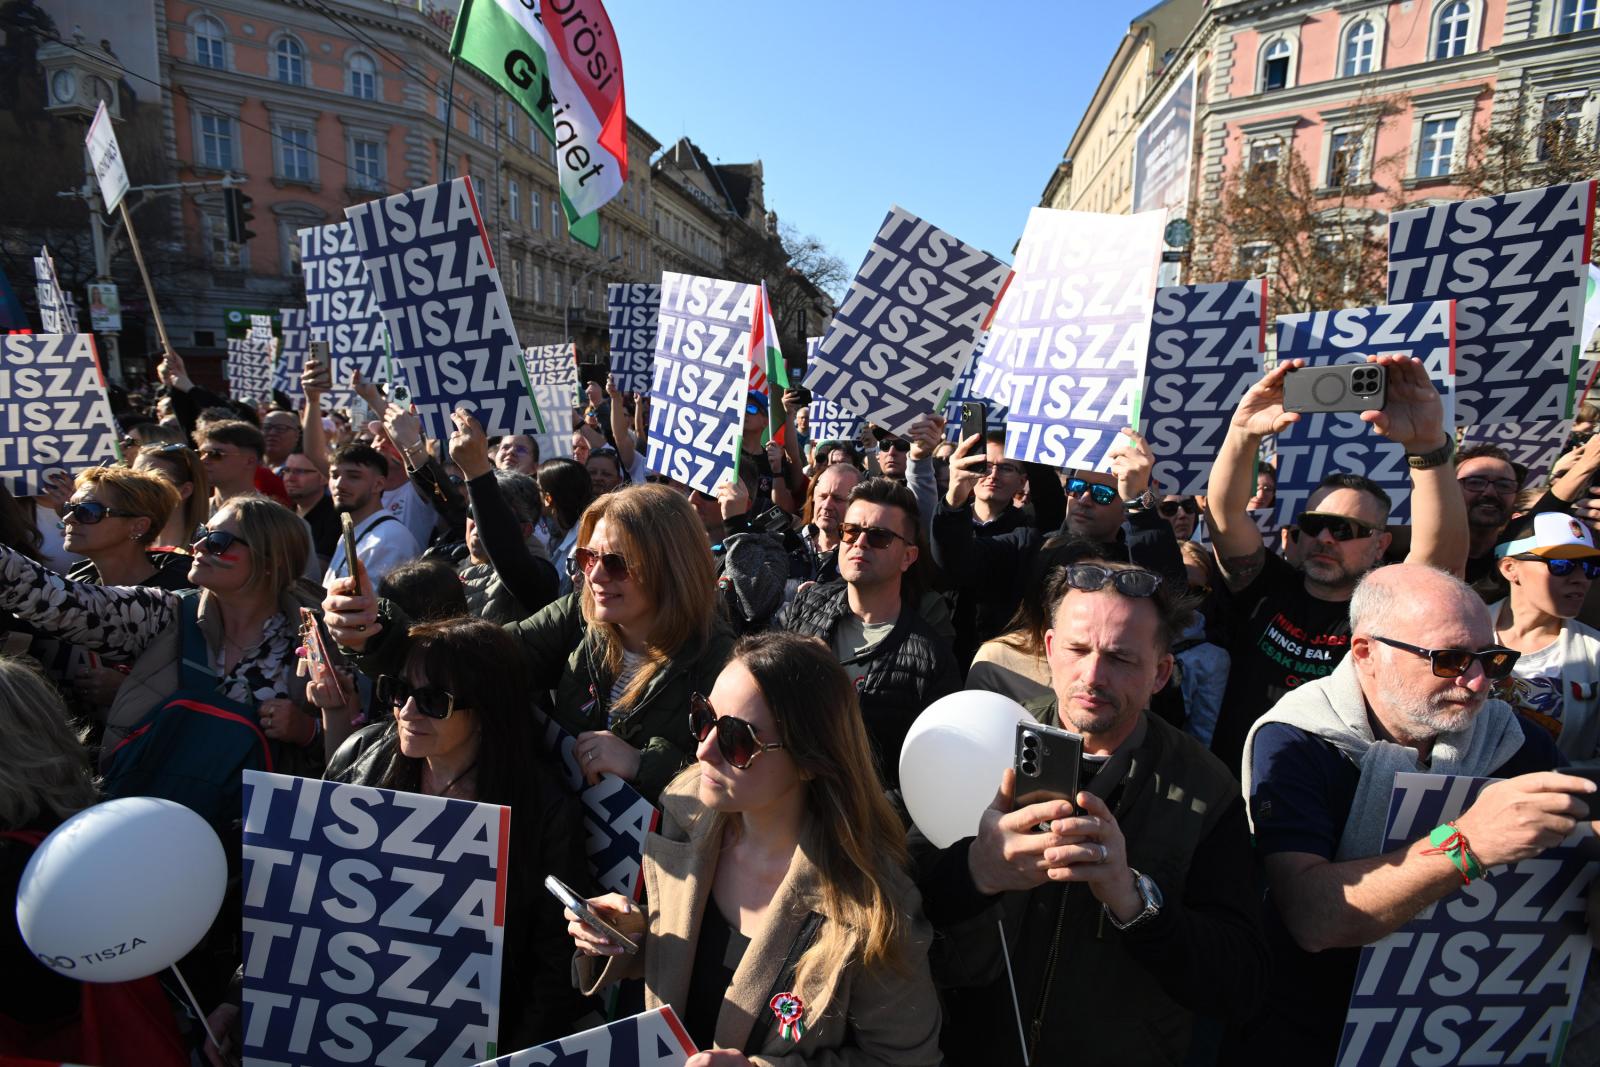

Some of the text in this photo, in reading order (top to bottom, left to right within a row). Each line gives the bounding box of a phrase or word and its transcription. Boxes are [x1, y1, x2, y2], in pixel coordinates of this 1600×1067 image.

[297, 221, 356, 257] TISZ
[343, 176, 480, 252] TISZA
[1389, 182, 1590, 254] TISZA
[302, 255, 369, 290] TISZ
[363, 235, 496, 303] TISZA
[878, 204, 1013, 300] TISZA
[1388, 234, 1583, 301] TISZA
[607, 283, 661, 304] TISZ
[662, 270, 758, 325] TISZA
[859, 242, 992, 337] TISZA
[1020, 267, 1154, 321] TISZA
[1152, 281, 1263, 326] SZA
[1455, 285, 1578, 341] SZA
[382, 290, 512, 351] TISZA
[608, 306, 660, 327] TISZ
[839, 280, 973, 374] TISZA
[1276, 300, 1450, 352] TISZA
[0, 334, 96, 365] SZA
[227, 338, 270, 354] TISZA
[228, 351, 271, 367] TISZA
[331, 355, 389, 384] ISZA
[527, 343, 576, 360] TISZA
[528, 357, 577, 374] TISZA
[654, 314, 752, 373] TISZA
[820, 318, 953, 411] TISZA
[1014, 322, 1146, 370] TISZA
[1150, 325, 1262, 370] SZA
[1455, 335, 1573, 387] SZA
[0, 367, 104, 399] ISZA
[228, 363, 272, 380] TISZA
[228, 376, 272, 392] TISZA
[400, 344, 527, 398] TISZA
[652, 356, 750, 417] TISZA
[0, 401, 113, 433] ISZA
[1009, 374, 1138, 424] TISZA
[1455, 383, 1568, 426] SZA
[648, 396, 746, 462] TISZA
[1277, 442, 1412, 484] TISZ
[1261, 641, 1294, 668] CSAK
[1267, 627, 1303, 656] NINCS
[242, 769, 501, 869] TISZA
[242, 844, 497, 943] TISZA
[1411, 858, 1592, 923] SZA
[81, 937, 148, 964] TISZA
[242, 917, 494, 1015] TISZA
[1356, 931, 1592, 997] TISZA
[1335, 1004, 1574, 1067] TISZA
